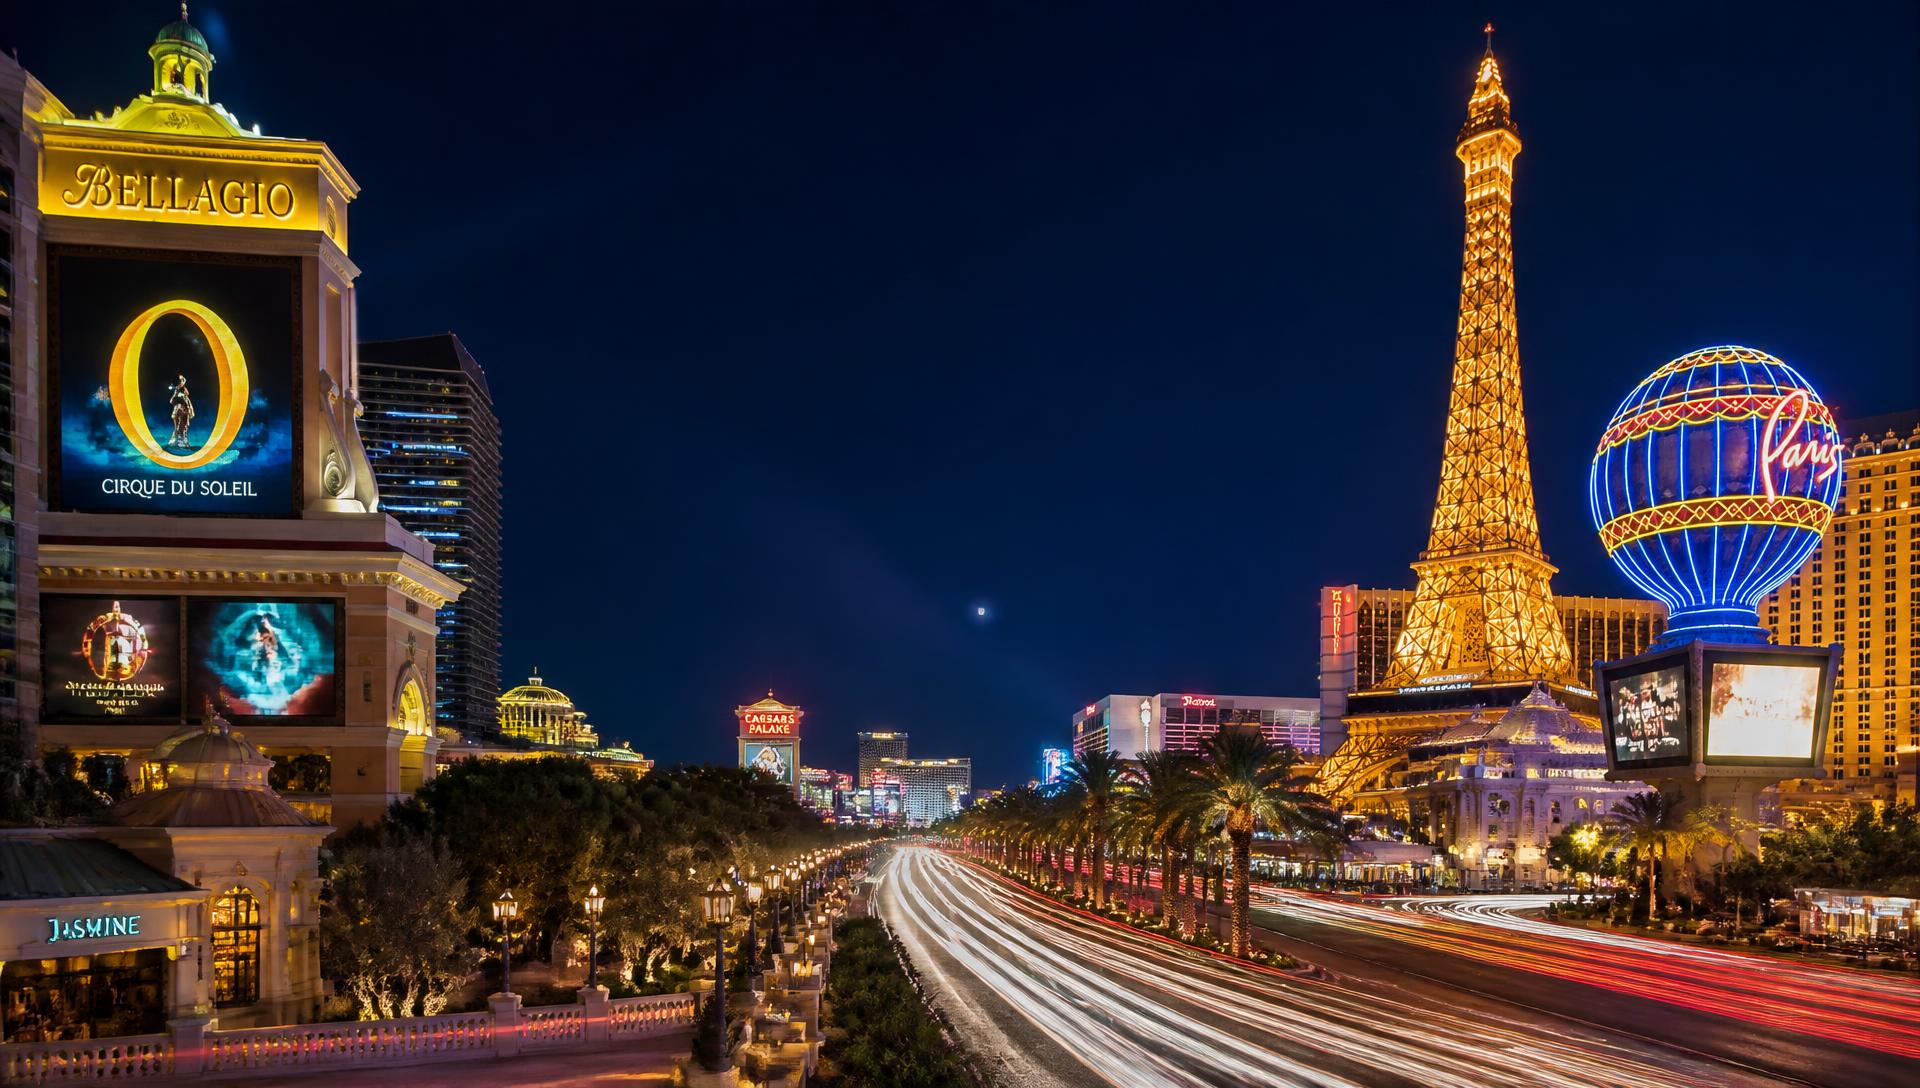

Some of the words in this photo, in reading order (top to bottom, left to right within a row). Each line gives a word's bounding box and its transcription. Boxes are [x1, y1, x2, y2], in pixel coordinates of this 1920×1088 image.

[62, 163, 294, 219] BELLAGIO
[108, 299, 249, 470] O
[101, 478, 165, 499] CIRQUE
[171, 480, 194, 495] DU
[200, 480, 258, 497] SOLEIL
[1762, 389, 1845, 504] Paris
